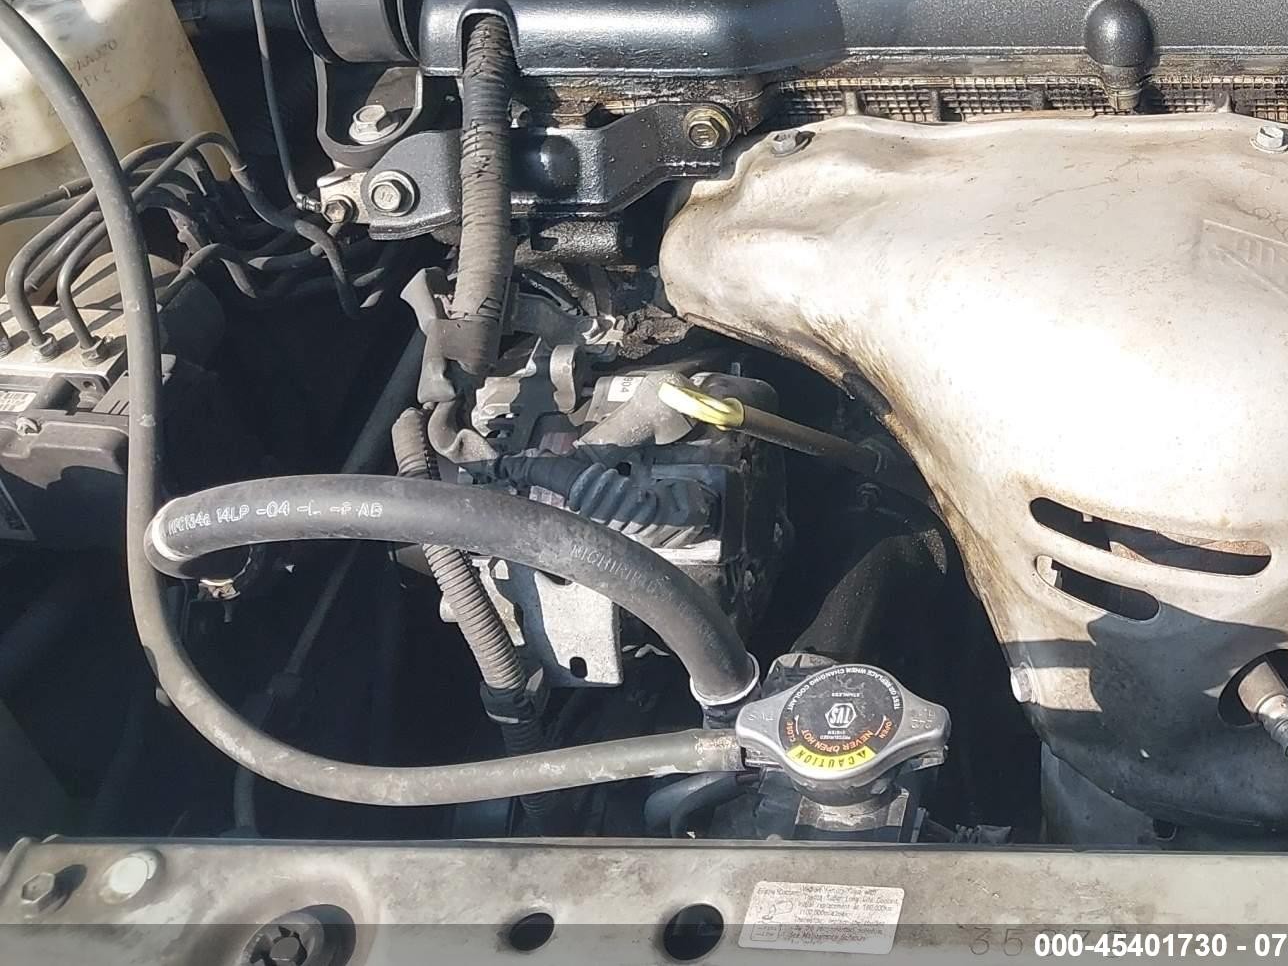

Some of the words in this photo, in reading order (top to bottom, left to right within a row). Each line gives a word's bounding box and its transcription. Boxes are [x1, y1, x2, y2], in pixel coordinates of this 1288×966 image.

[809, 667, 845, 686] CHANGING
[867, 669, 893, 688] REPLACE
[786, 684, 810, 711] COOLANT
[830, 707, 851, 725] TVS
[800, 729, 817, 749] HOT
[879, 720, 893, 739] OPEN
[816, 738, 840, 753] OPEN
[842, 730, 874, 751] NEVER
[794, 749, 855, 768] CAUTION
